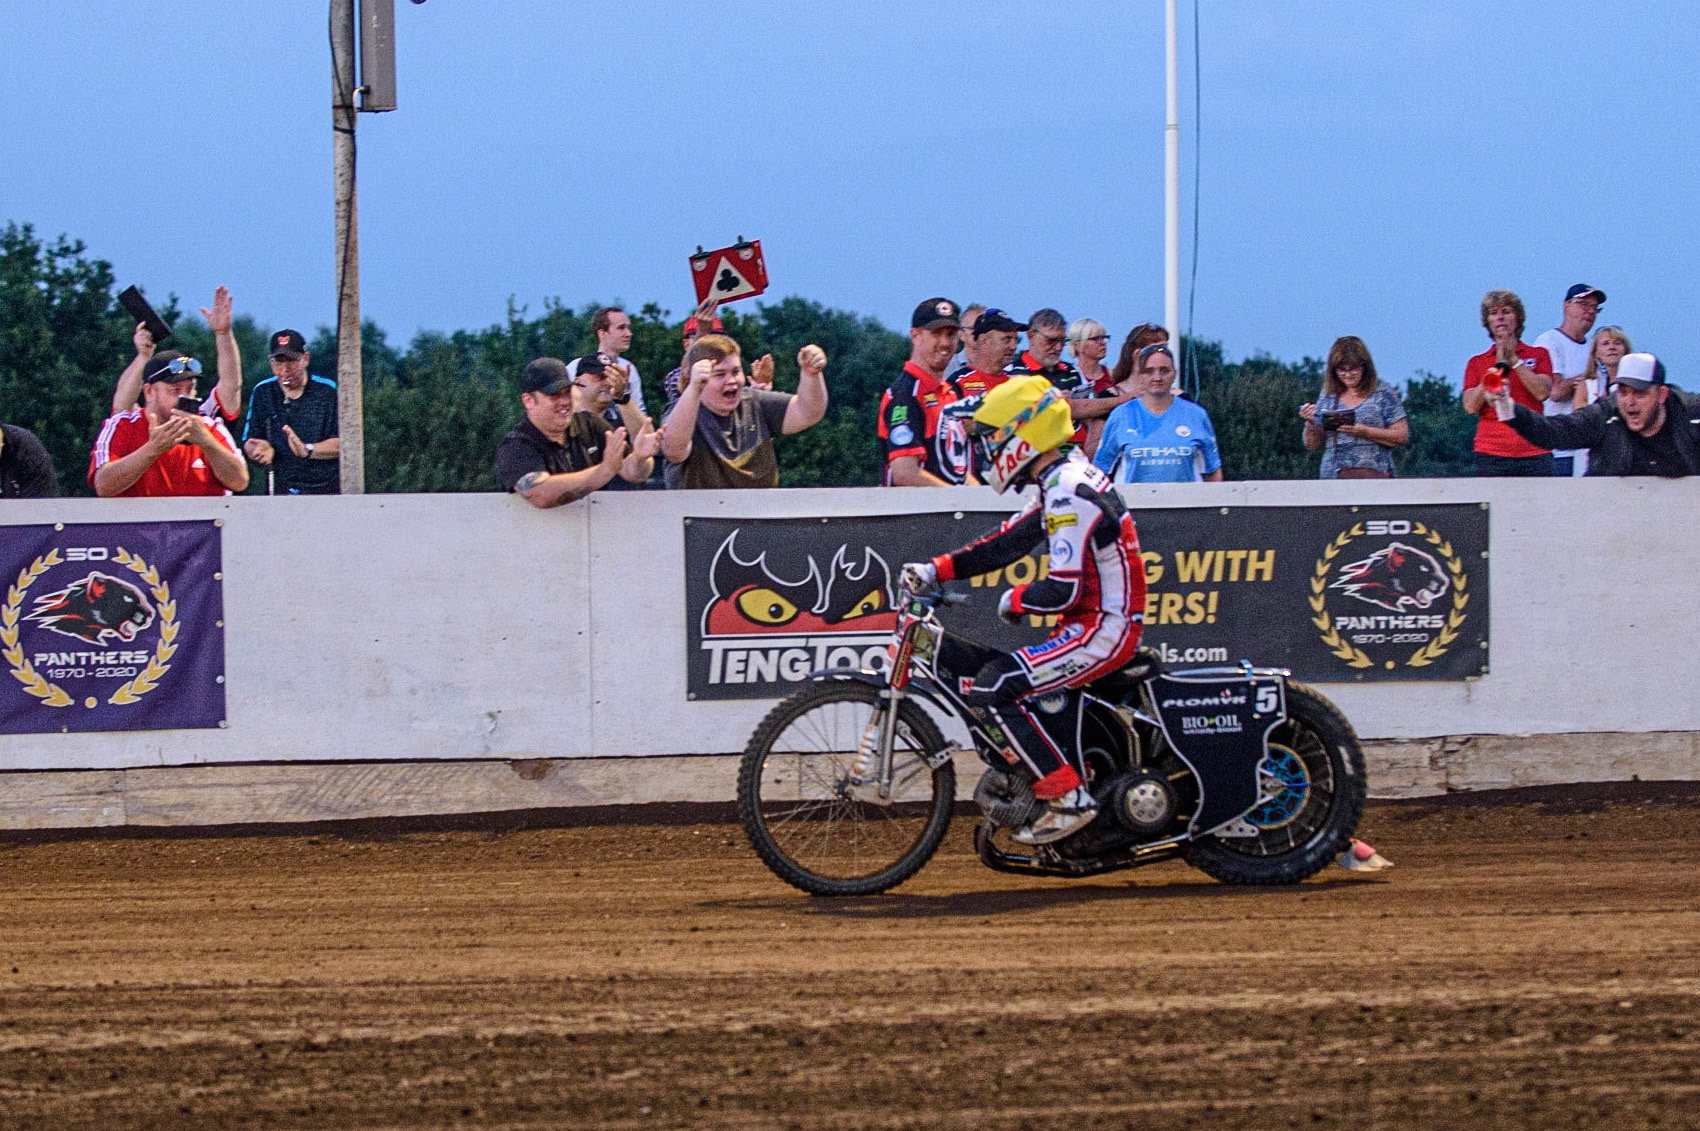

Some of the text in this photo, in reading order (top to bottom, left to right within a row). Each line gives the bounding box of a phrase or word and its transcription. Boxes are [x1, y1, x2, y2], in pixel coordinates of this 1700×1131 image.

[1130, 446, 1193, 458] ETIHAD
[1366, 520, 1411, 535] 50
[66, 547, 108, 561] 50
[1174, 549, 1276, 583] WITH
[1335, 615, 1445, 630] PANTHERS
[1351, 633, 1430, 644] 1970-2020
[34, 650, 149, 666] PANTHERS
[47, 667, 137, 679] 1970-2020
[1255, 686, 1279, 714] 5
